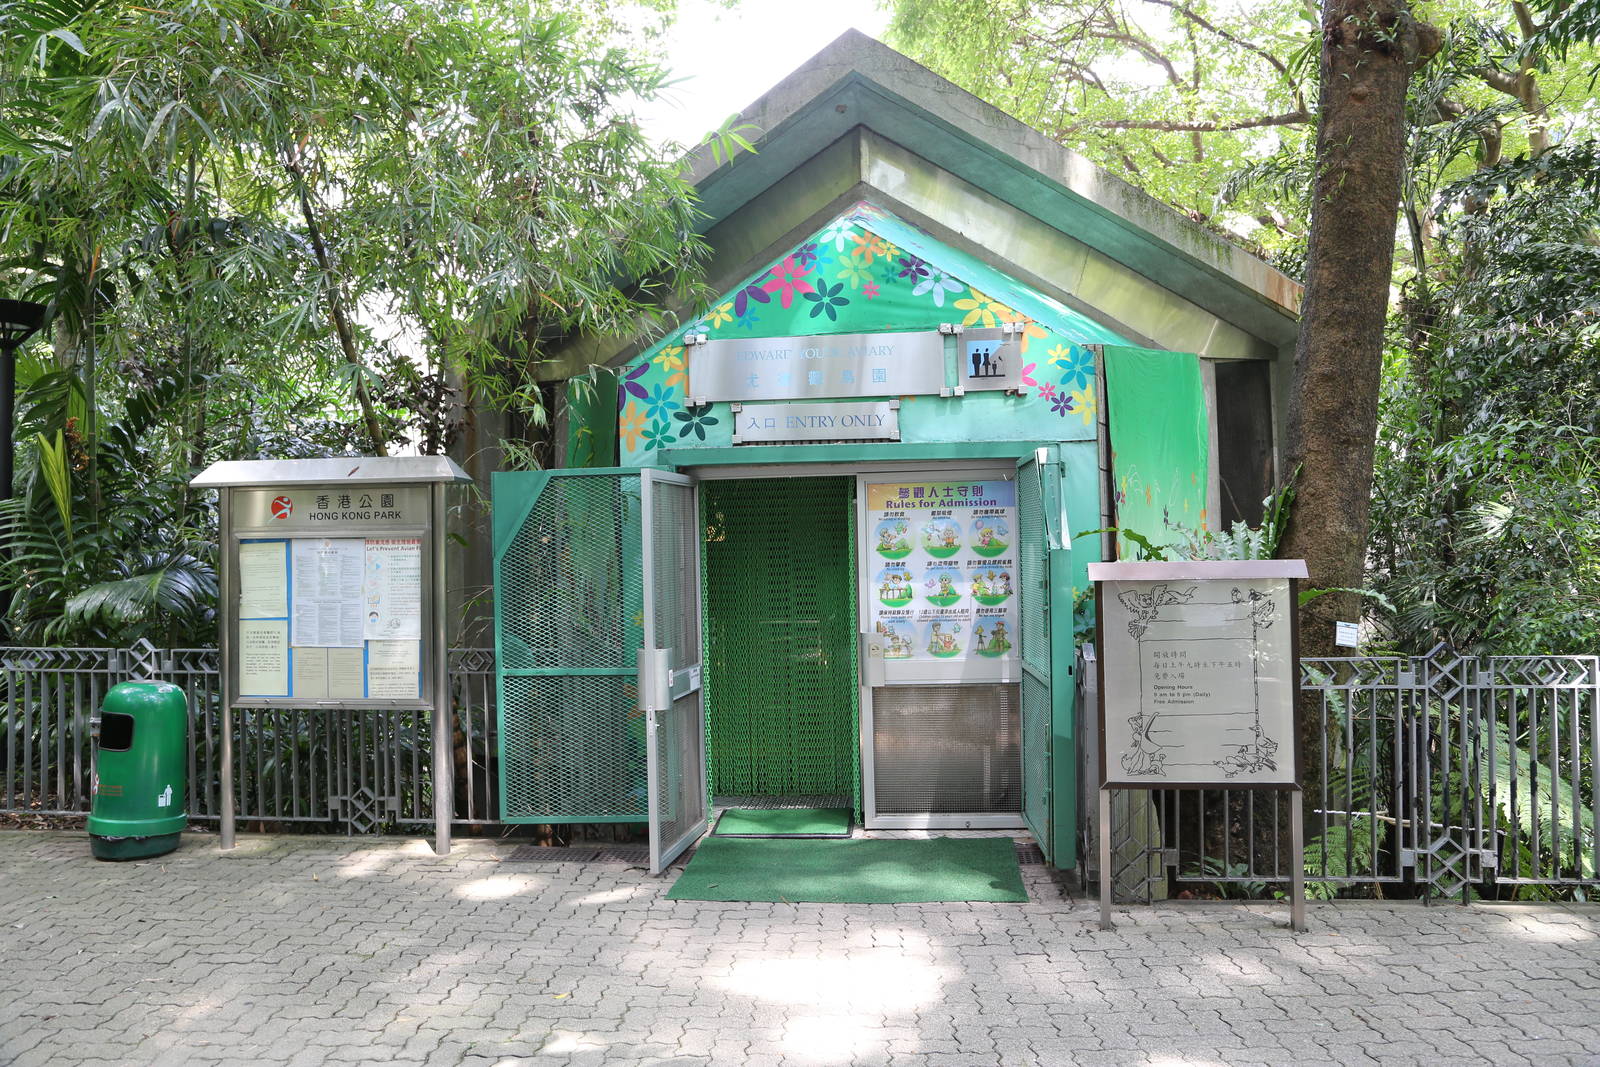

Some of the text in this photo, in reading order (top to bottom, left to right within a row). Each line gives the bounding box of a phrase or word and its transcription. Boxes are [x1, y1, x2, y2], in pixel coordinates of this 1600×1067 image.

[800, 346, 842, 360] YOU
[747, 417, 776, 429] 入口
[786, 414, 885, 429] ENTRY ONLY
[316, 493, 394, 510] 香港公園
[886, 498, 997, 509] Rules for Admission
[309, 511, 402, 521] HONG KONG PARK
